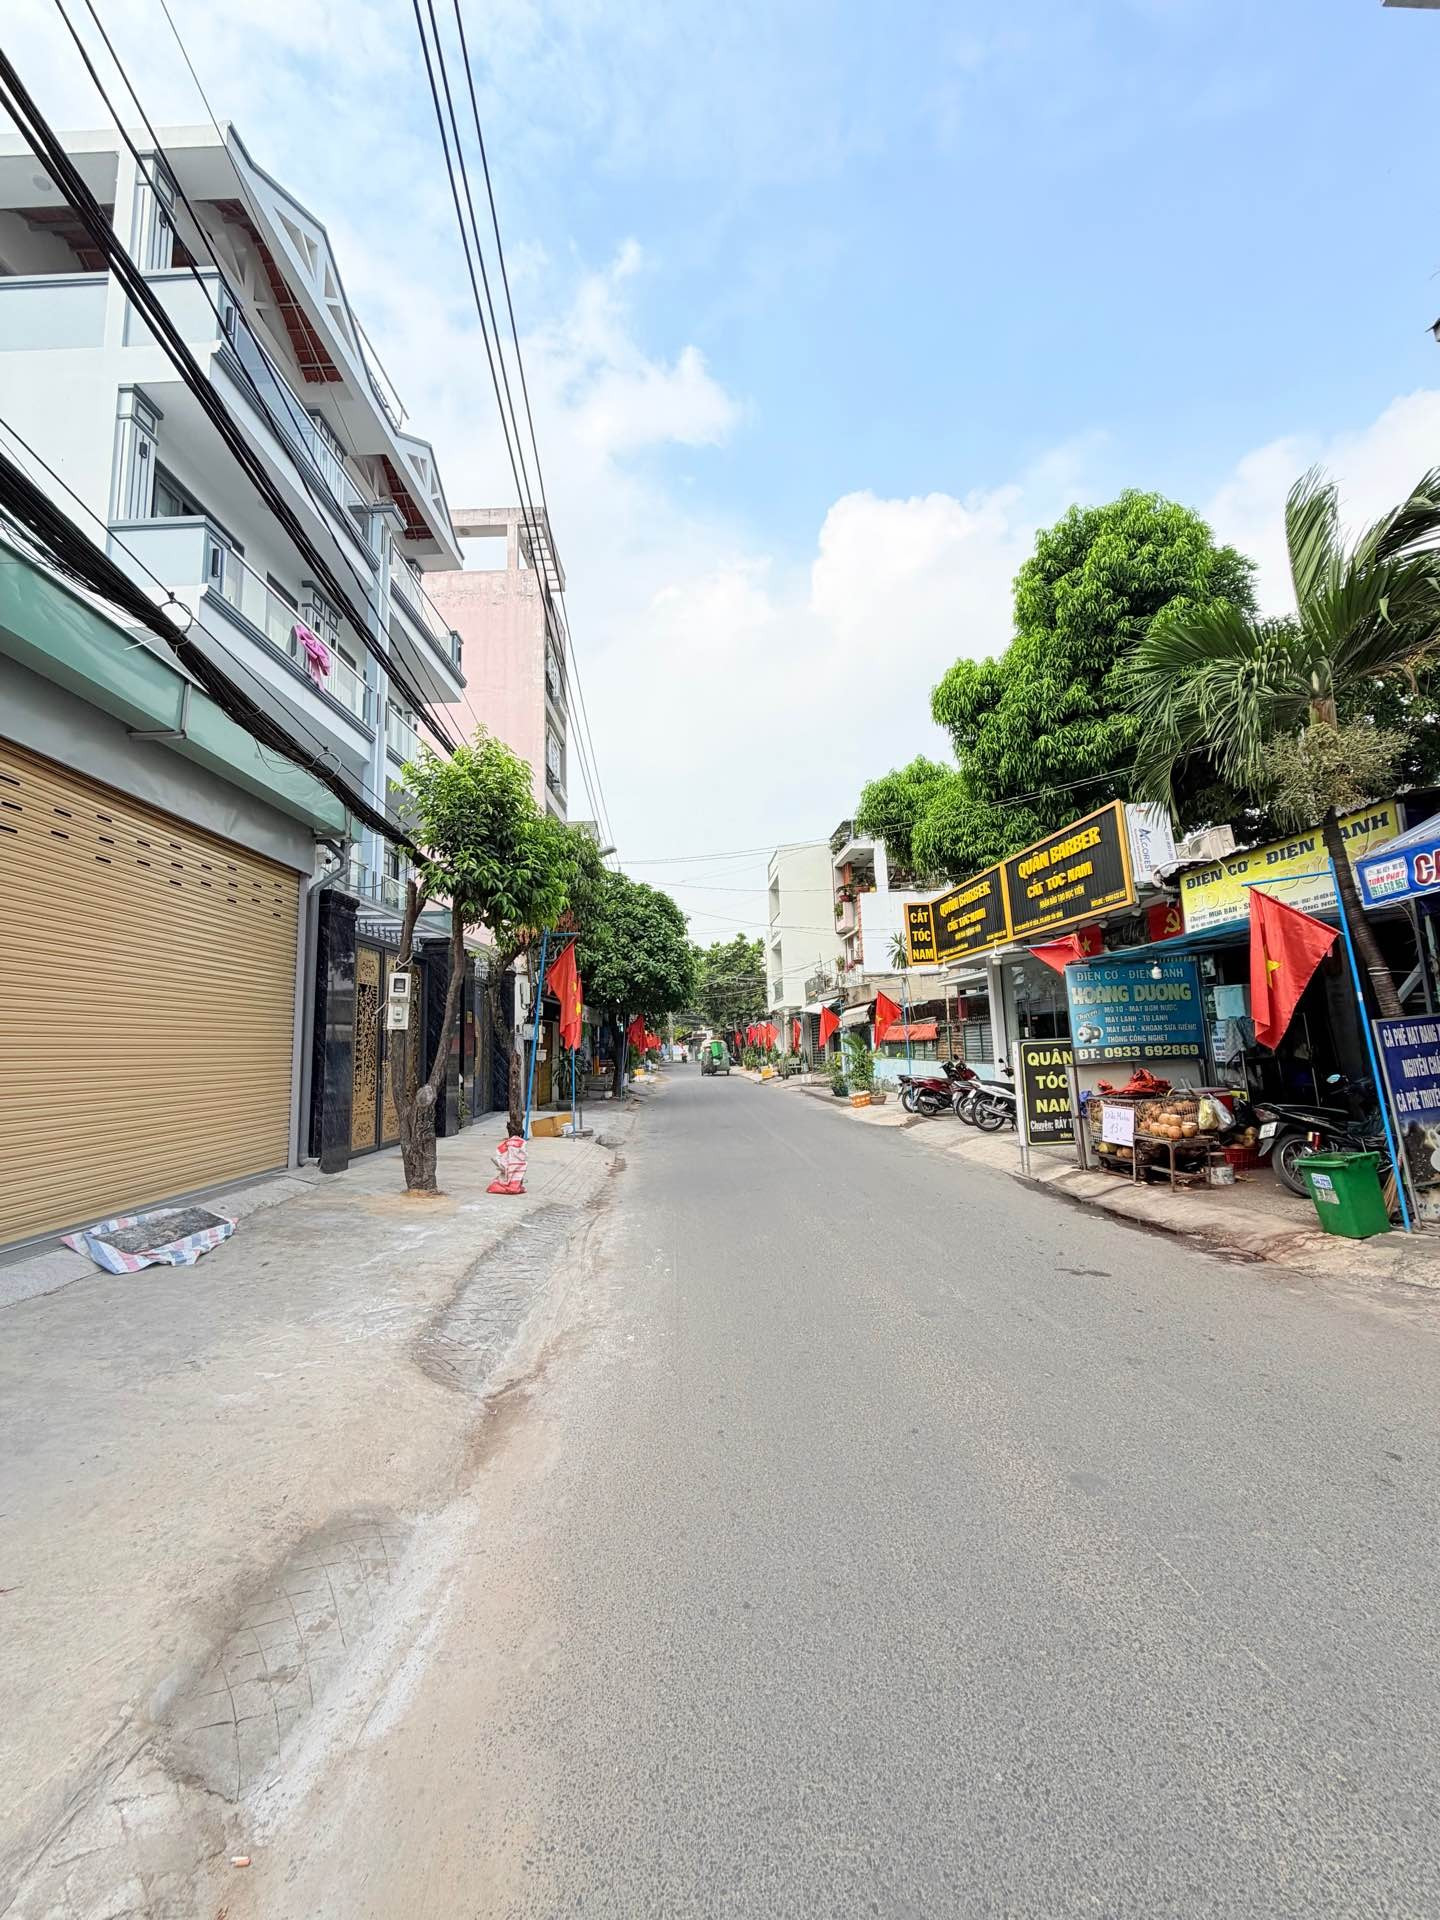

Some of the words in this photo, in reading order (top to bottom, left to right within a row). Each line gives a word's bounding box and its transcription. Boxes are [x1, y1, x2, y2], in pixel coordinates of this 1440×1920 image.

[1018, 851, 1050, 880] QUÂN
[1049, 826, 1101, 865] BARBER
[1186, 869, 1223, 890] ĐIỆN
[1227, 859, 1249, 877] CƠ
[1266, 838, 1315, 867] ĐIỆN
[1045, 871, 1067, 891] TÓC
[1067, 861, 1094, 883] NAM
[912, 928, 931, 942] TÓC
[912, 948, 934, 960] NAM
[1104, 969, 1119, 980] CƠ
[1071, 982, 1130, 1005] HOÀNG
[1027, 1048, 1073, 1066] QUÂN
[1078, 1048, 1100, 1060] ĐT:
[1104, 1046, 1141, 1058] 0933
[1144, 1044, 1199, 1057] 692869
[1035, 1071, 1068, 1089] TÓC
[1036, 1098, 1072, 1113] NAM
